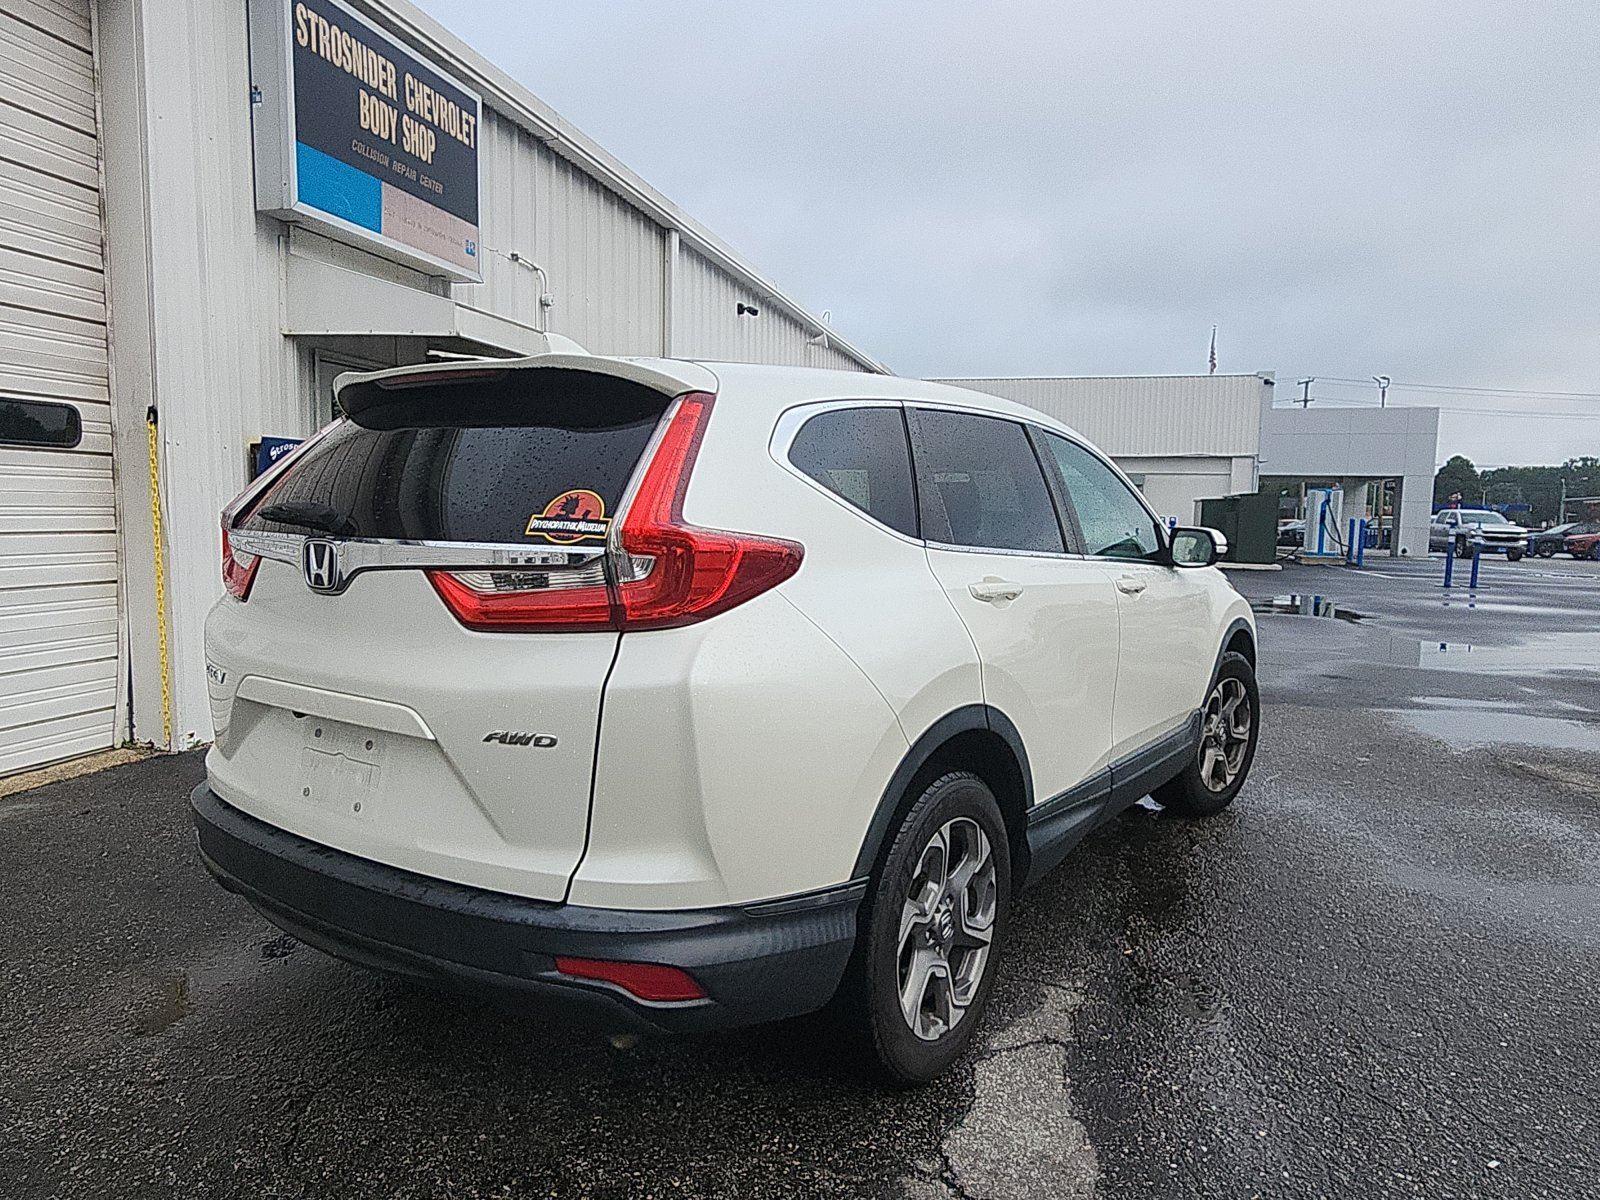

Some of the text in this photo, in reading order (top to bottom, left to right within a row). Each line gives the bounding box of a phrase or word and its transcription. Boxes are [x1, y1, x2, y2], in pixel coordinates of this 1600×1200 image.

[296, 2, 475, 149] STROSNIDER CHEVROLET
[359, 88, 436, 165] BODY SHOP
[351, 139, 443, 194] COLLISION REPAIR CENTER
[482, 731, 558, 748] AWD
